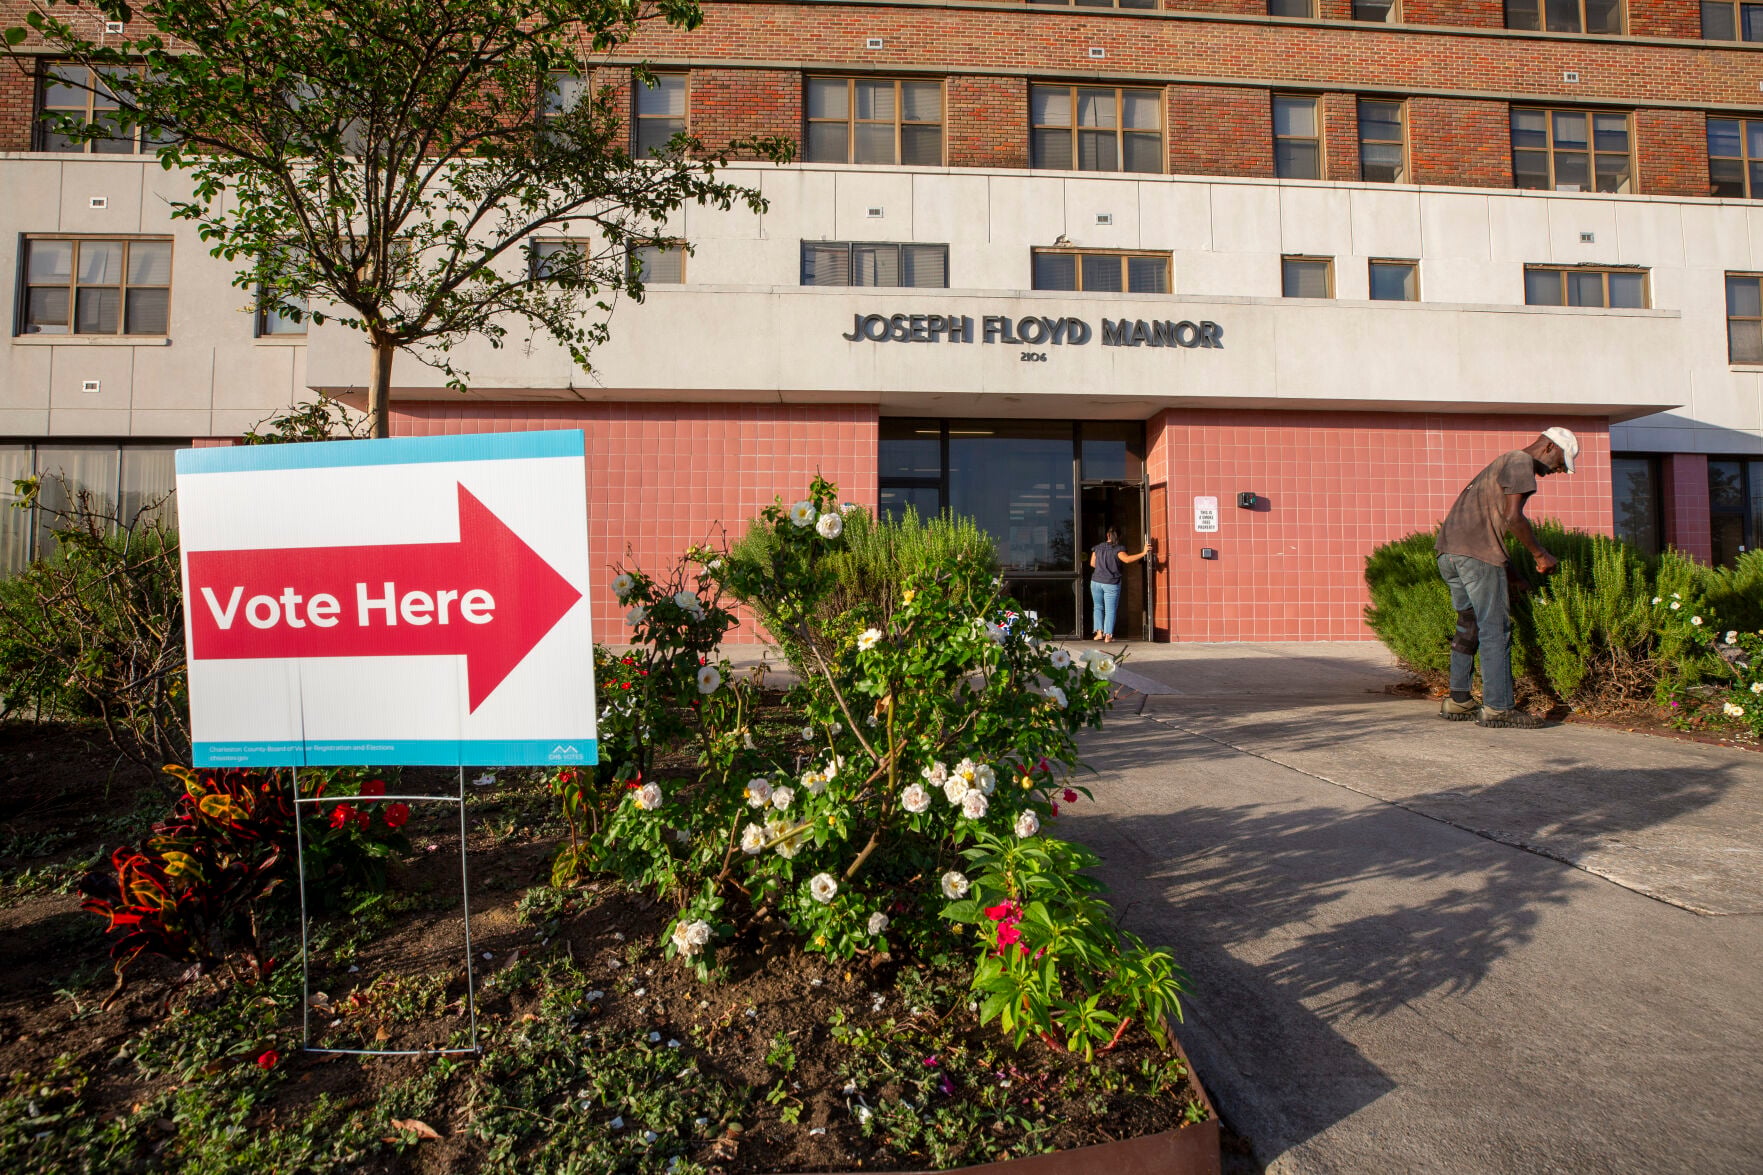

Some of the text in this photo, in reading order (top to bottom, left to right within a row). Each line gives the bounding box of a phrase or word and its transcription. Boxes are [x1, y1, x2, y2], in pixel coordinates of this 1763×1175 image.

[842, 314, 1223, 348] JOSEPH FLOYD MANOR
[1020, 351, 1047, 362] 2106
[200, 581, 496, 630] Vote Here
